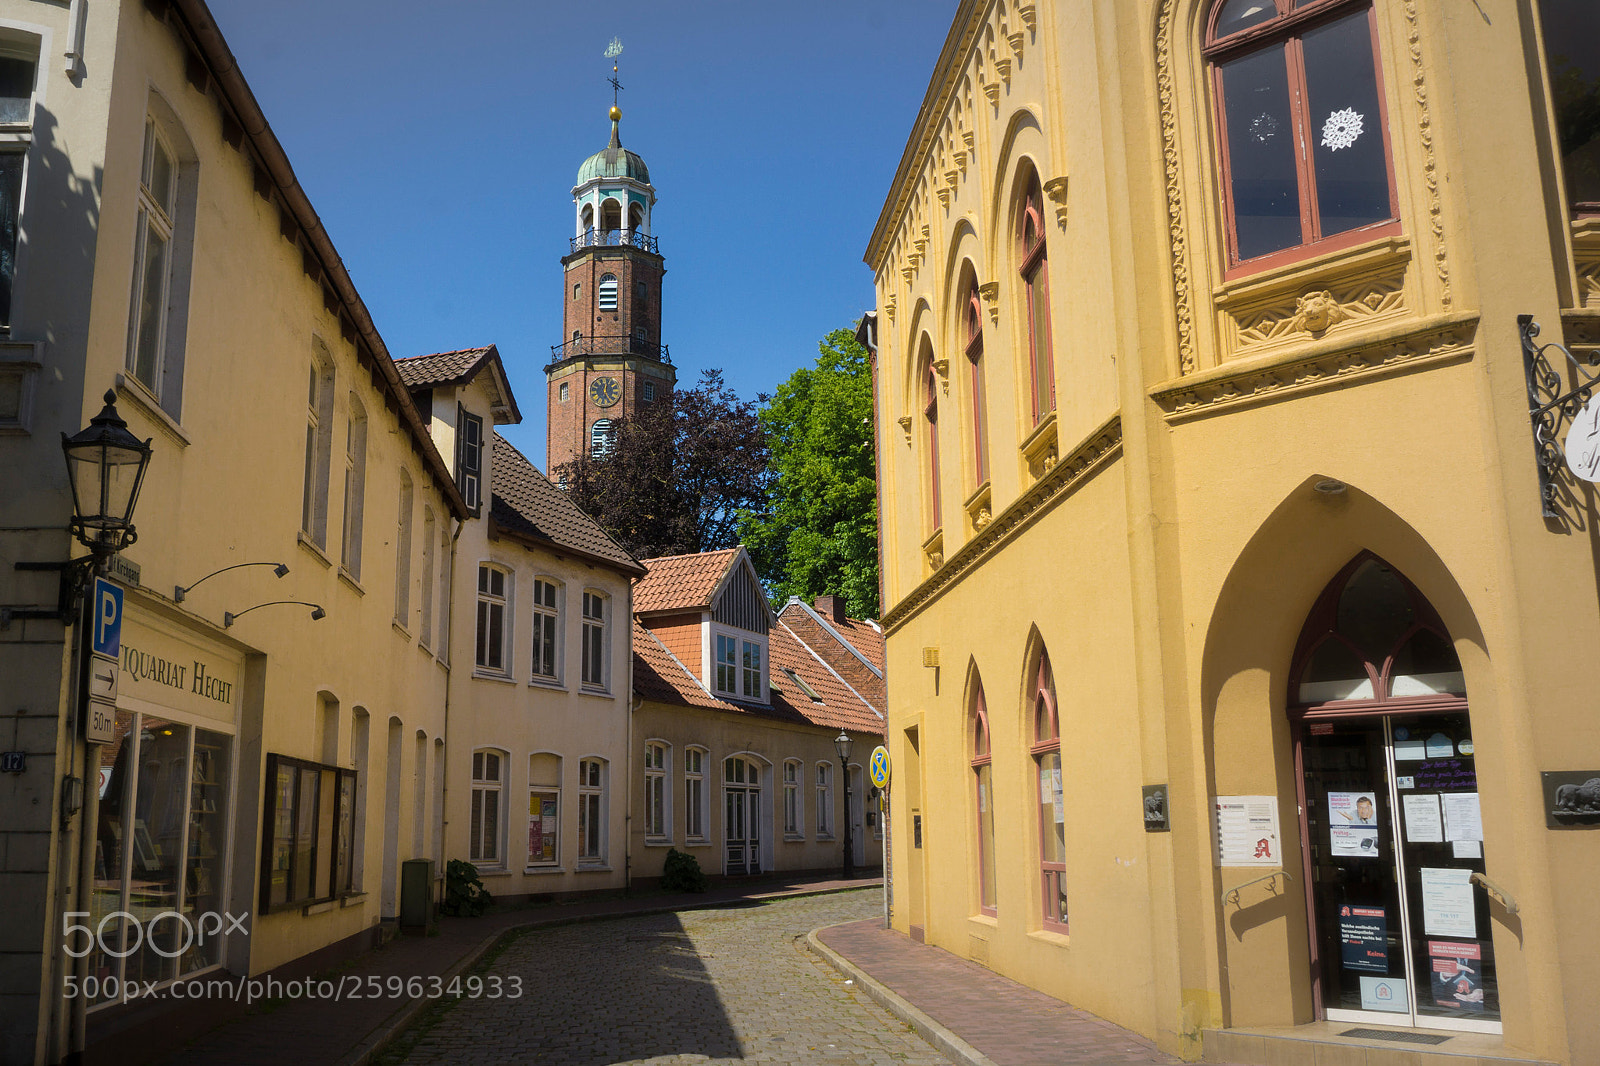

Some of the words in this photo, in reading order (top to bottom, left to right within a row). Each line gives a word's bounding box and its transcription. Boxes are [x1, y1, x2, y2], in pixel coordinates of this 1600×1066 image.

[101, 590, 117, 644] P
[120, 644, 187, 690] IQUARIAT
[191, 660, 232, 705] HECHT
[93, 711, 112, 733] 50m
[7, 753, 21, 769] 17
